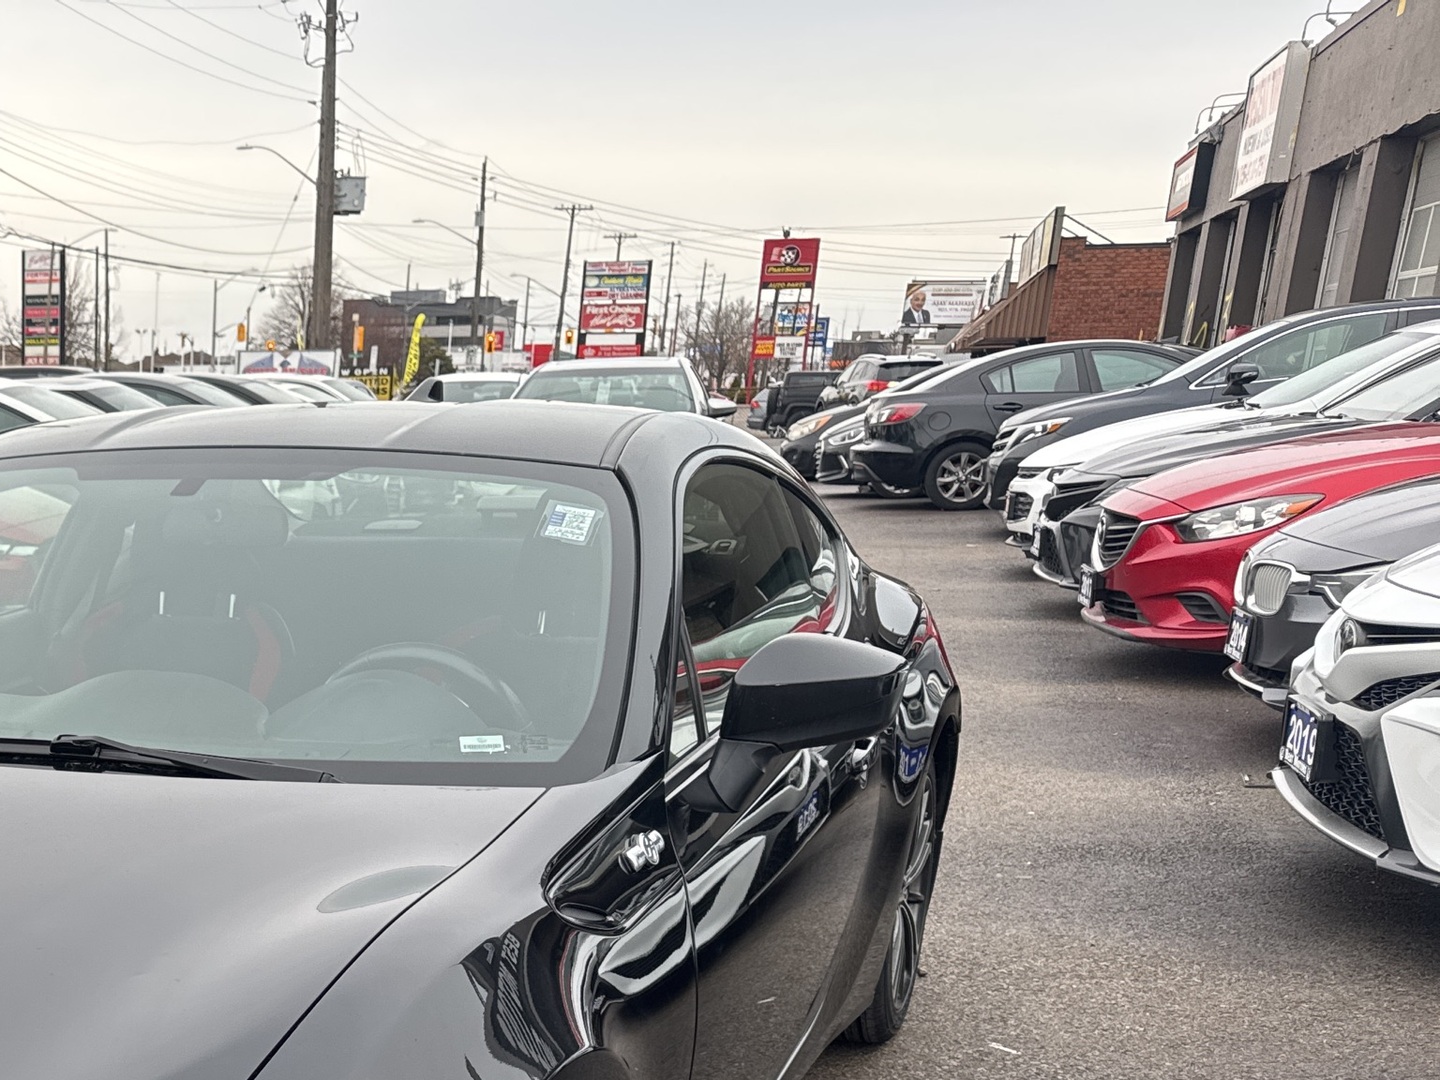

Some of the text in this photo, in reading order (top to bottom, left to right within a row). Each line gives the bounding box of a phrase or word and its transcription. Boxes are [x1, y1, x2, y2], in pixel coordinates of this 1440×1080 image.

[586, 305, 641, 314] First Choice
[1229, 619, 1249, 653] 2014
[1286, 714, 1318, 766] 2019
